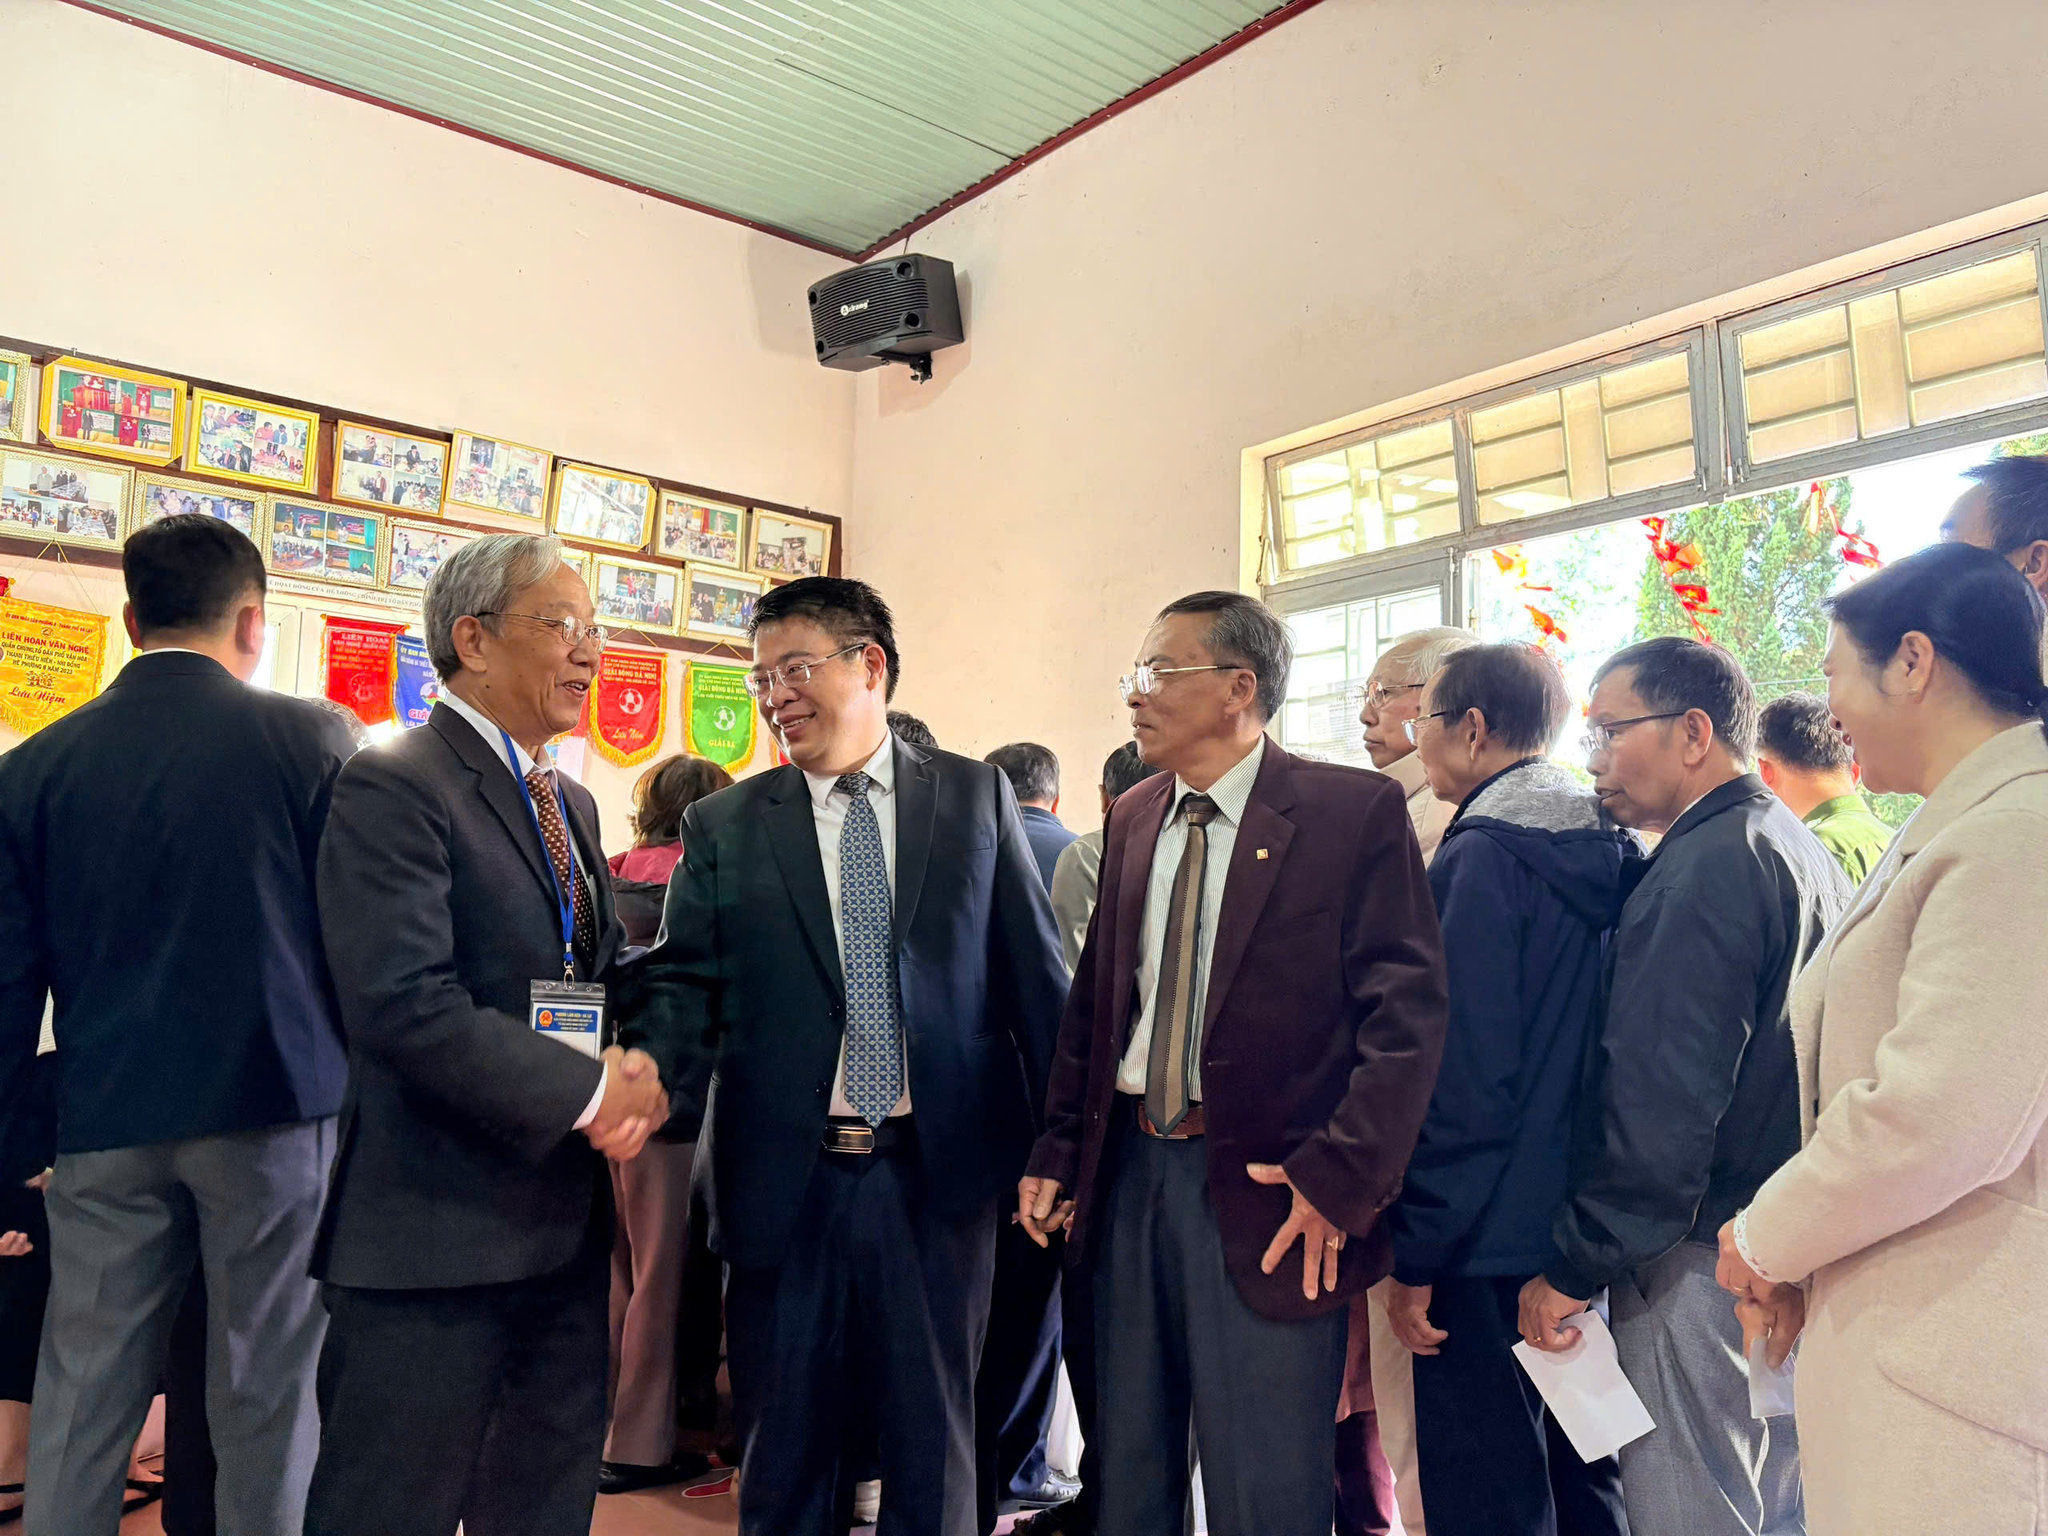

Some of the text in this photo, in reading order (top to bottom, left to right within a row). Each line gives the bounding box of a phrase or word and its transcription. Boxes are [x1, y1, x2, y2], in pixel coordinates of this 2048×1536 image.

[2, 632, 89, 655] LIÊN HOAN VĂN NGHỆ
[6, 651, 23, 659] THANH
[24, 652, 39, 661] THIẾU
[54, 650, 65, 658] PHỐ
[21, 661, 41, 669] PHƯỜNG
[8, 686, 66, 704] Lưu Niệm
